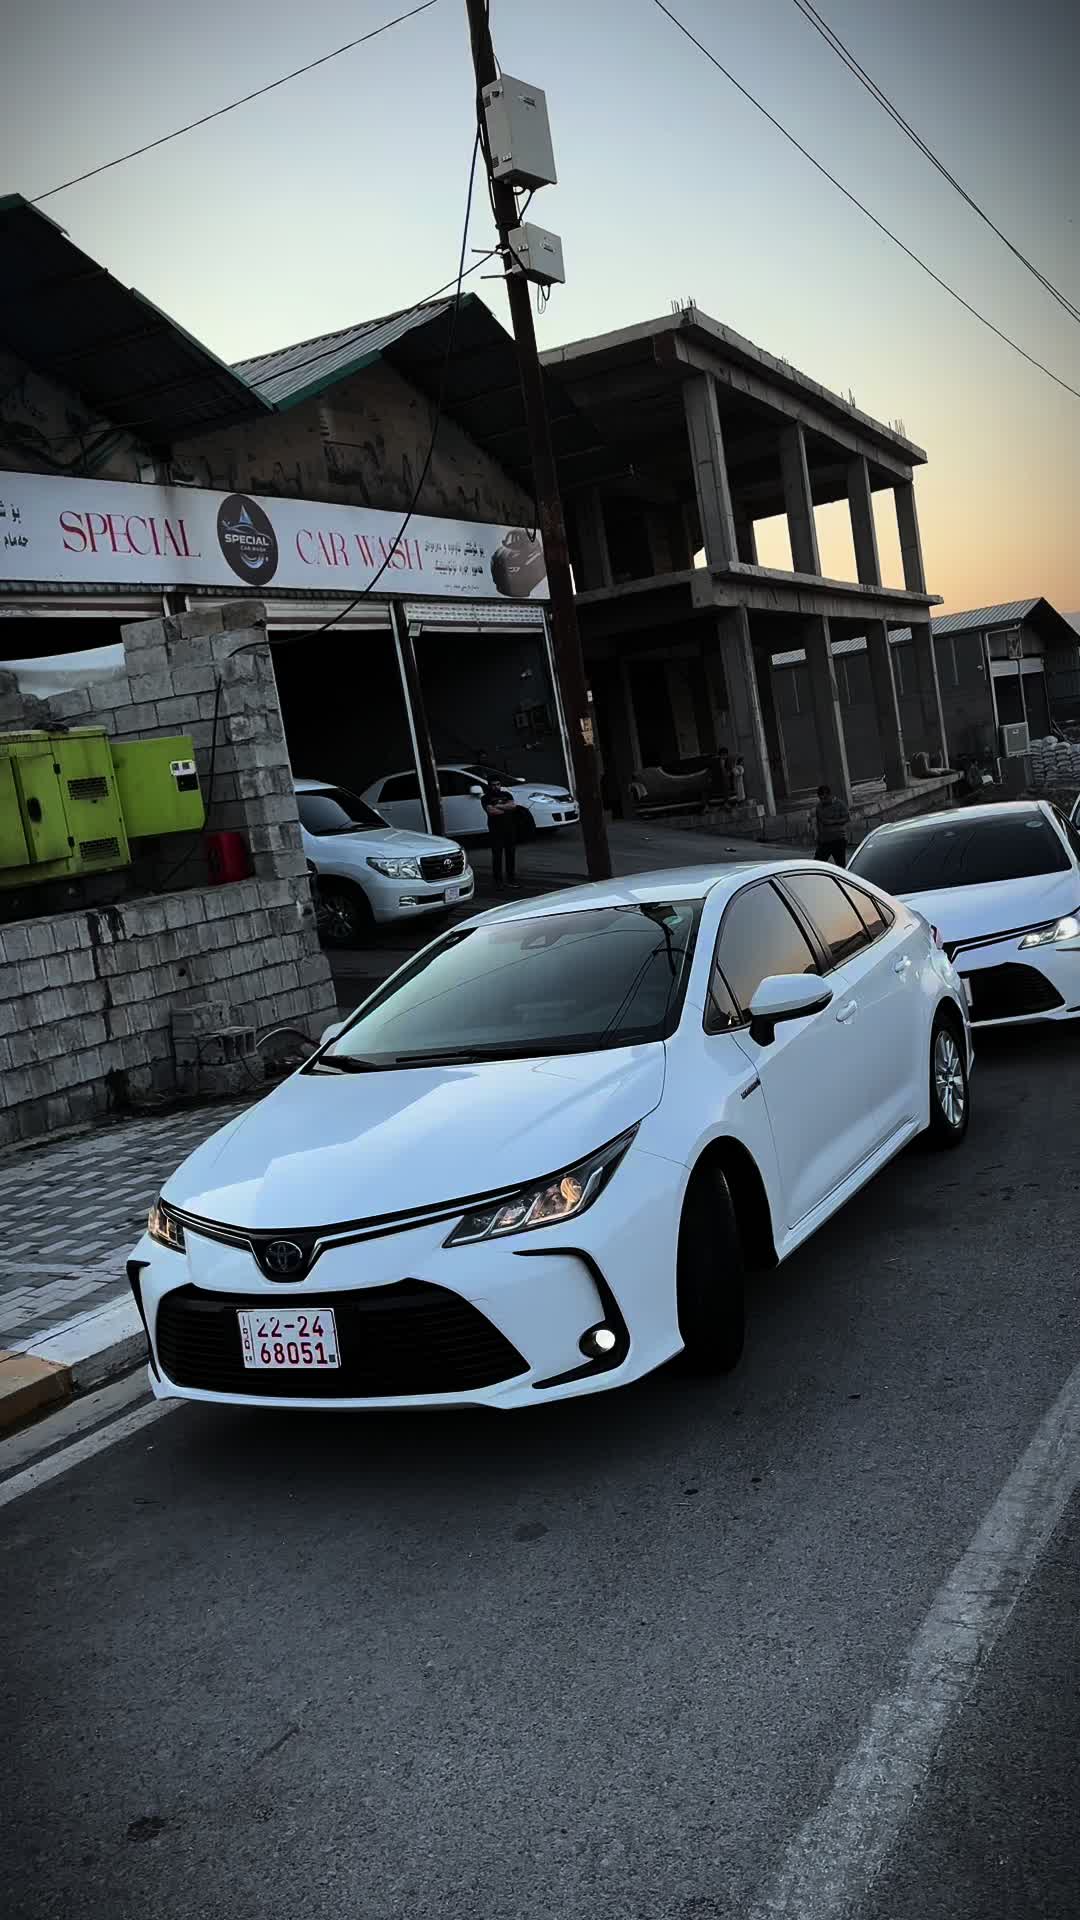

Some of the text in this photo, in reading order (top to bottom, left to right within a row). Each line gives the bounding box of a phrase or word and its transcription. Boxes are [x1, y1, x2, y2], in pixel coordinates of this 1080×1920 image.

[59, 510, 202, 557] SPECIAL
[224, 533, 270, 546] SPECIAL
[295, 528, 350, 566] CAR
[353, 534, 423, 570] WASH
[260, 1342, 328, 1365] 68051
